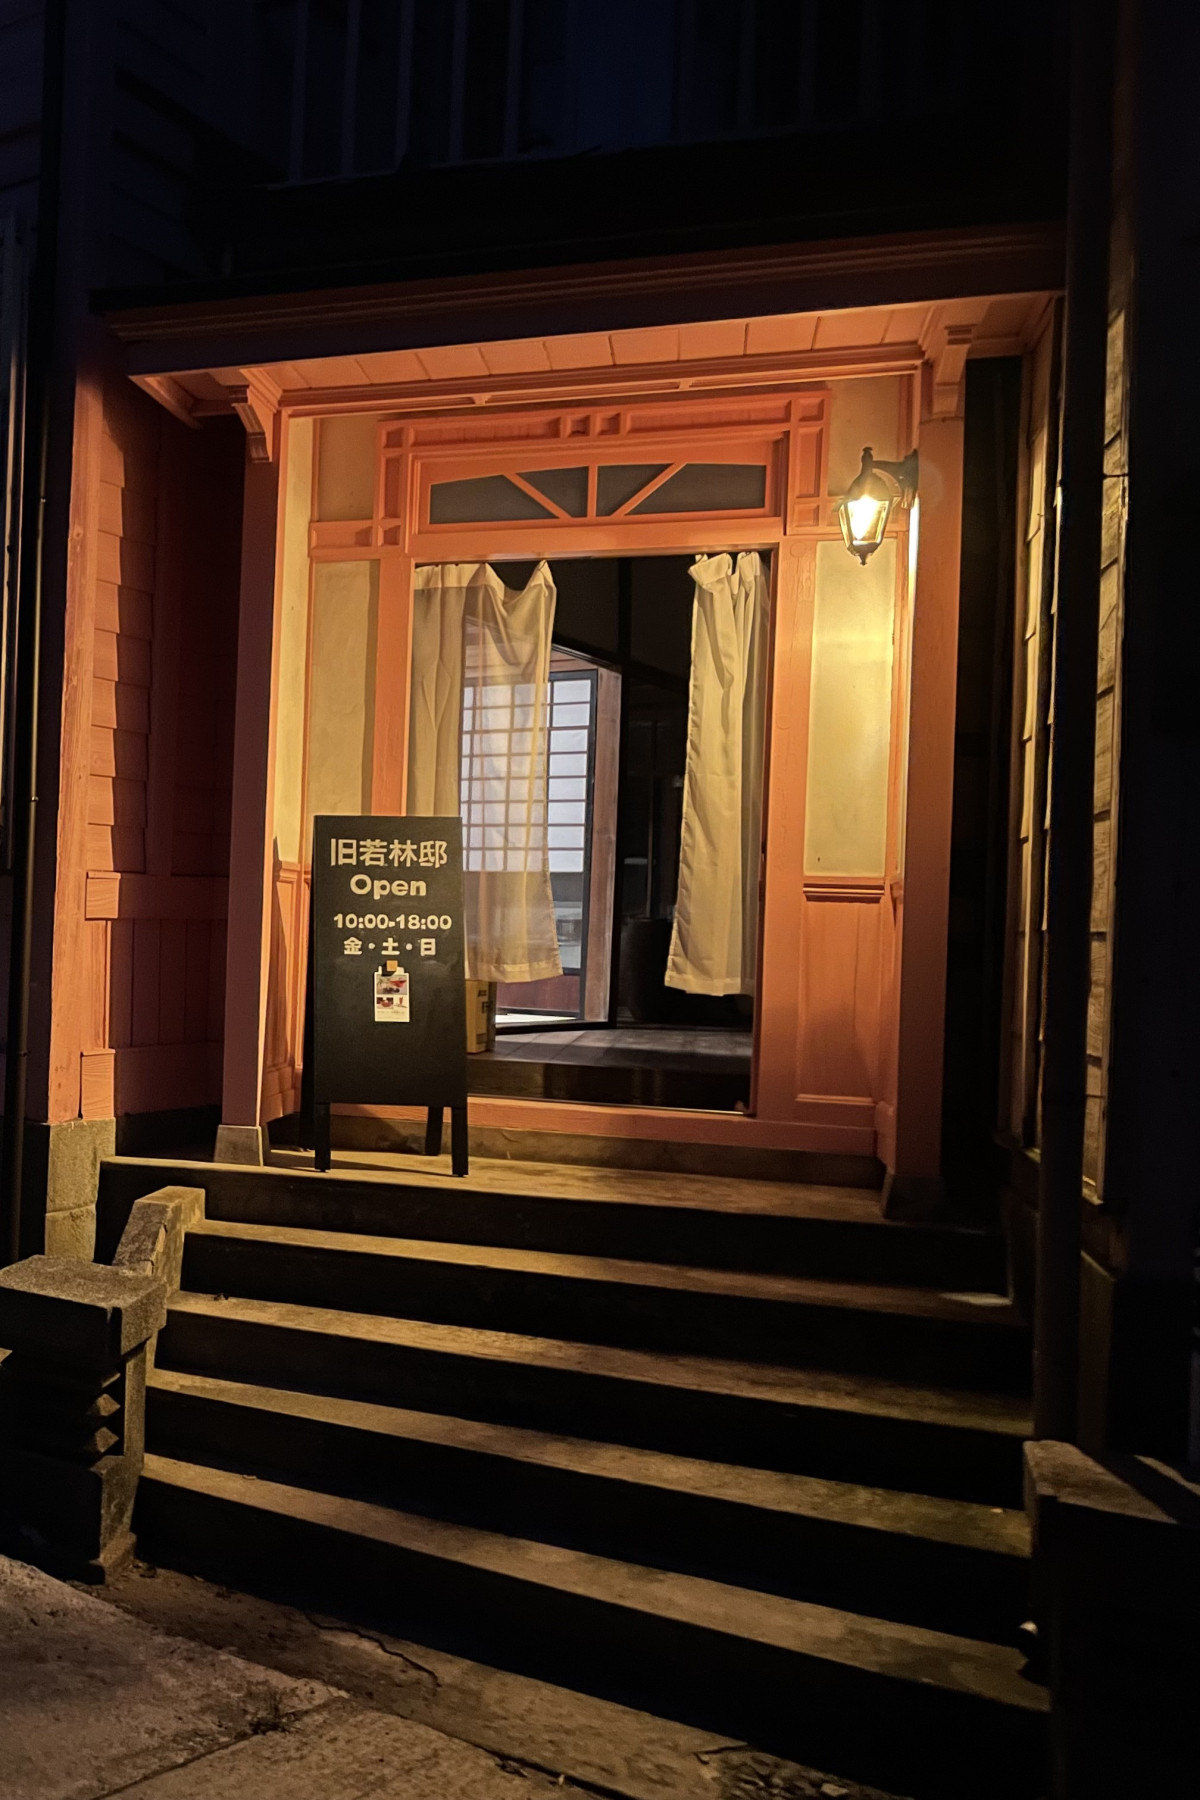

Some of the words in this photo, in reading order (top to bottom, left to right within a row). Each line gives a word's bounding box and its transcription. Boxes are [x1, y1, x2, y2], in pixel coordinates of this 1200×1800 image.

[330, 838, 448, 868] 旧若林邸
[350, 874, 427, 900] Open
[333, 913, 452, 930] 10:00-18:00
